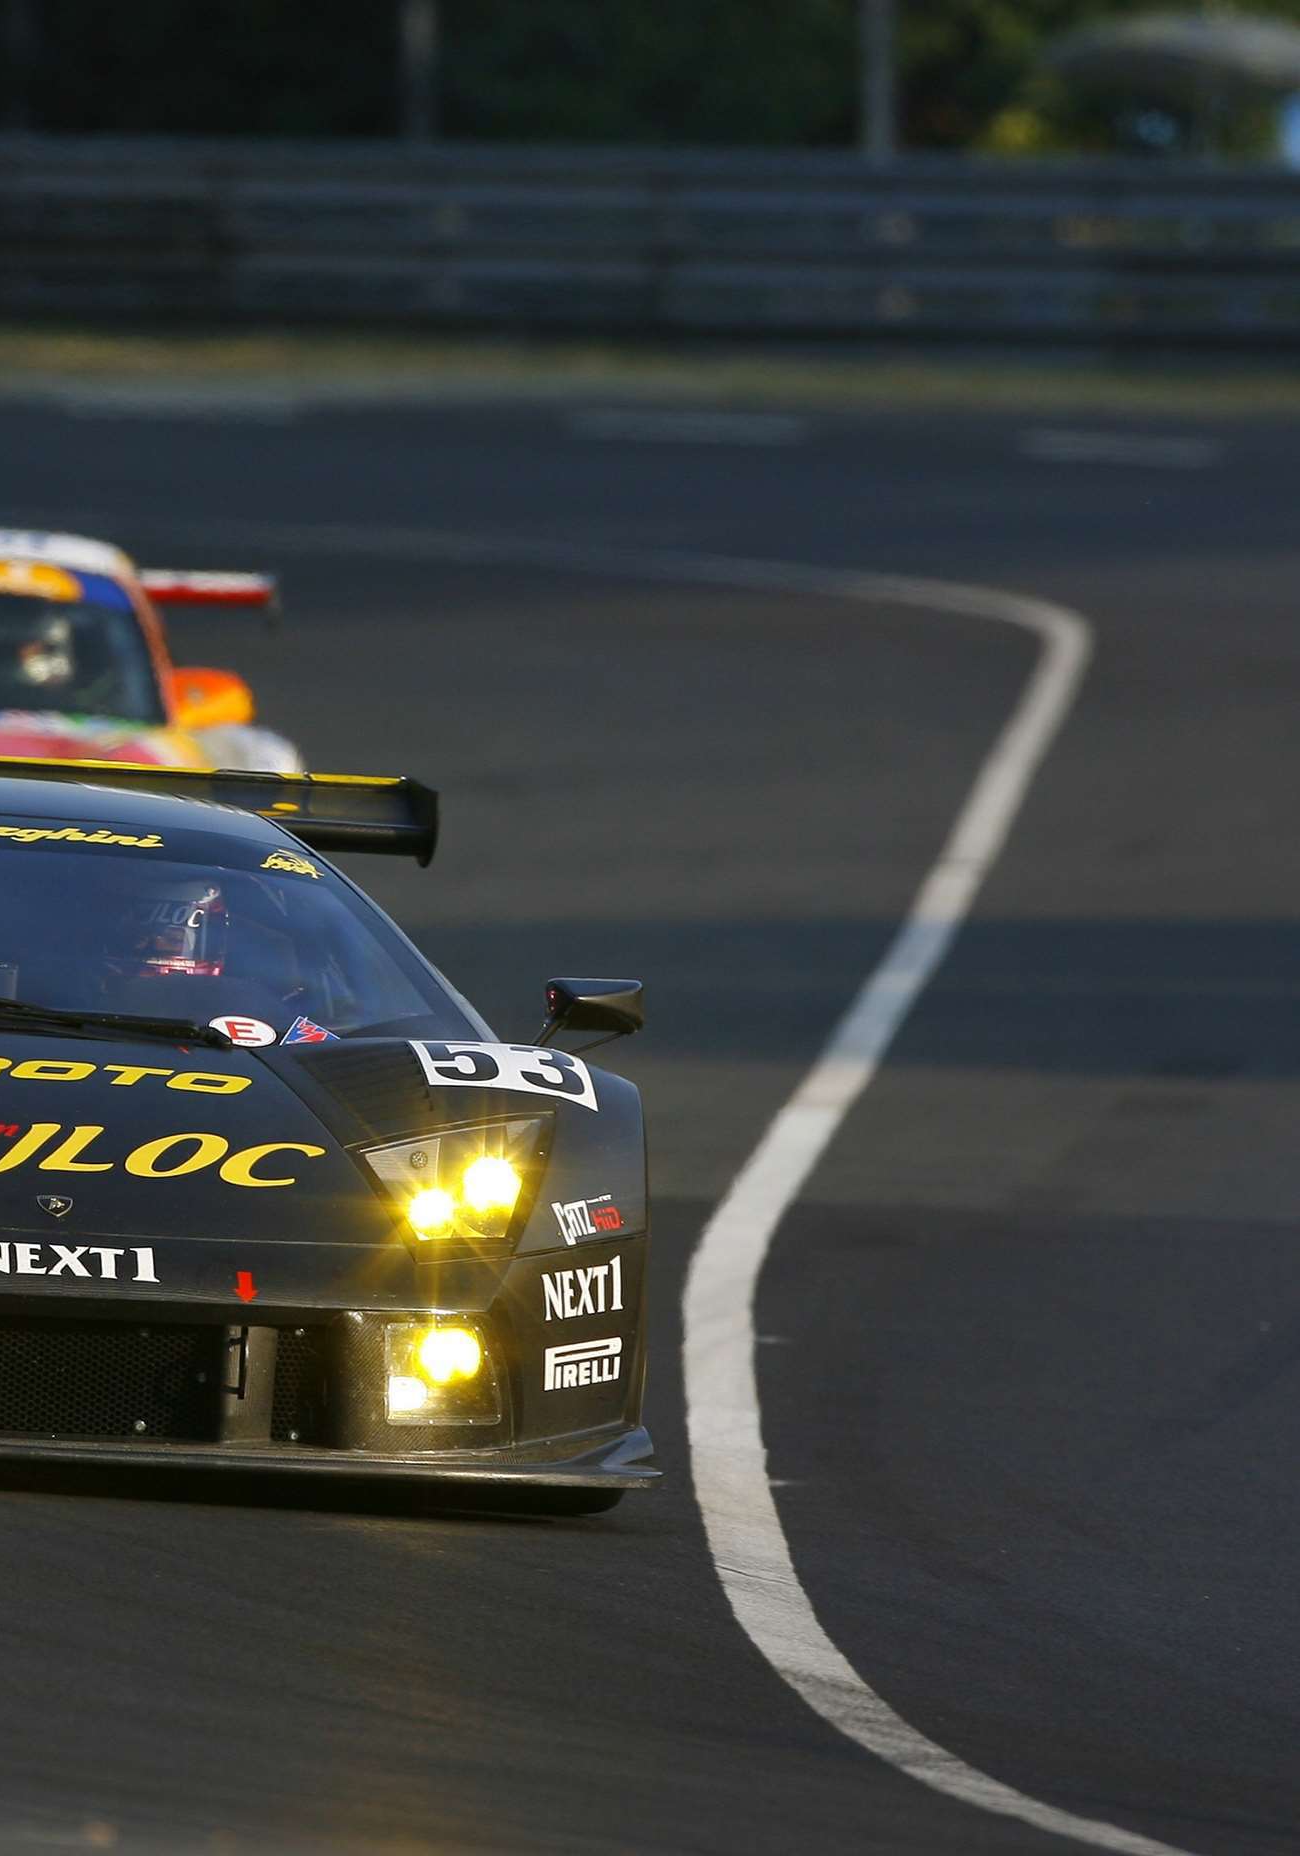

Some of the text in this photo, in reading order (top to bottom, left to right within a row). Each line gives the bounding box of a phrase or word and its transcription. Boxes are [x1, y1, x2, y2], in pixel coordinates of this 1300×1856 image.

[224, 1020, 262, 1042] E
[428, 1041, 585, 1096] 53
[540, 1254, 624, 1321] NEXT1
[543, 1335, 623, 1391] PIRELLI
